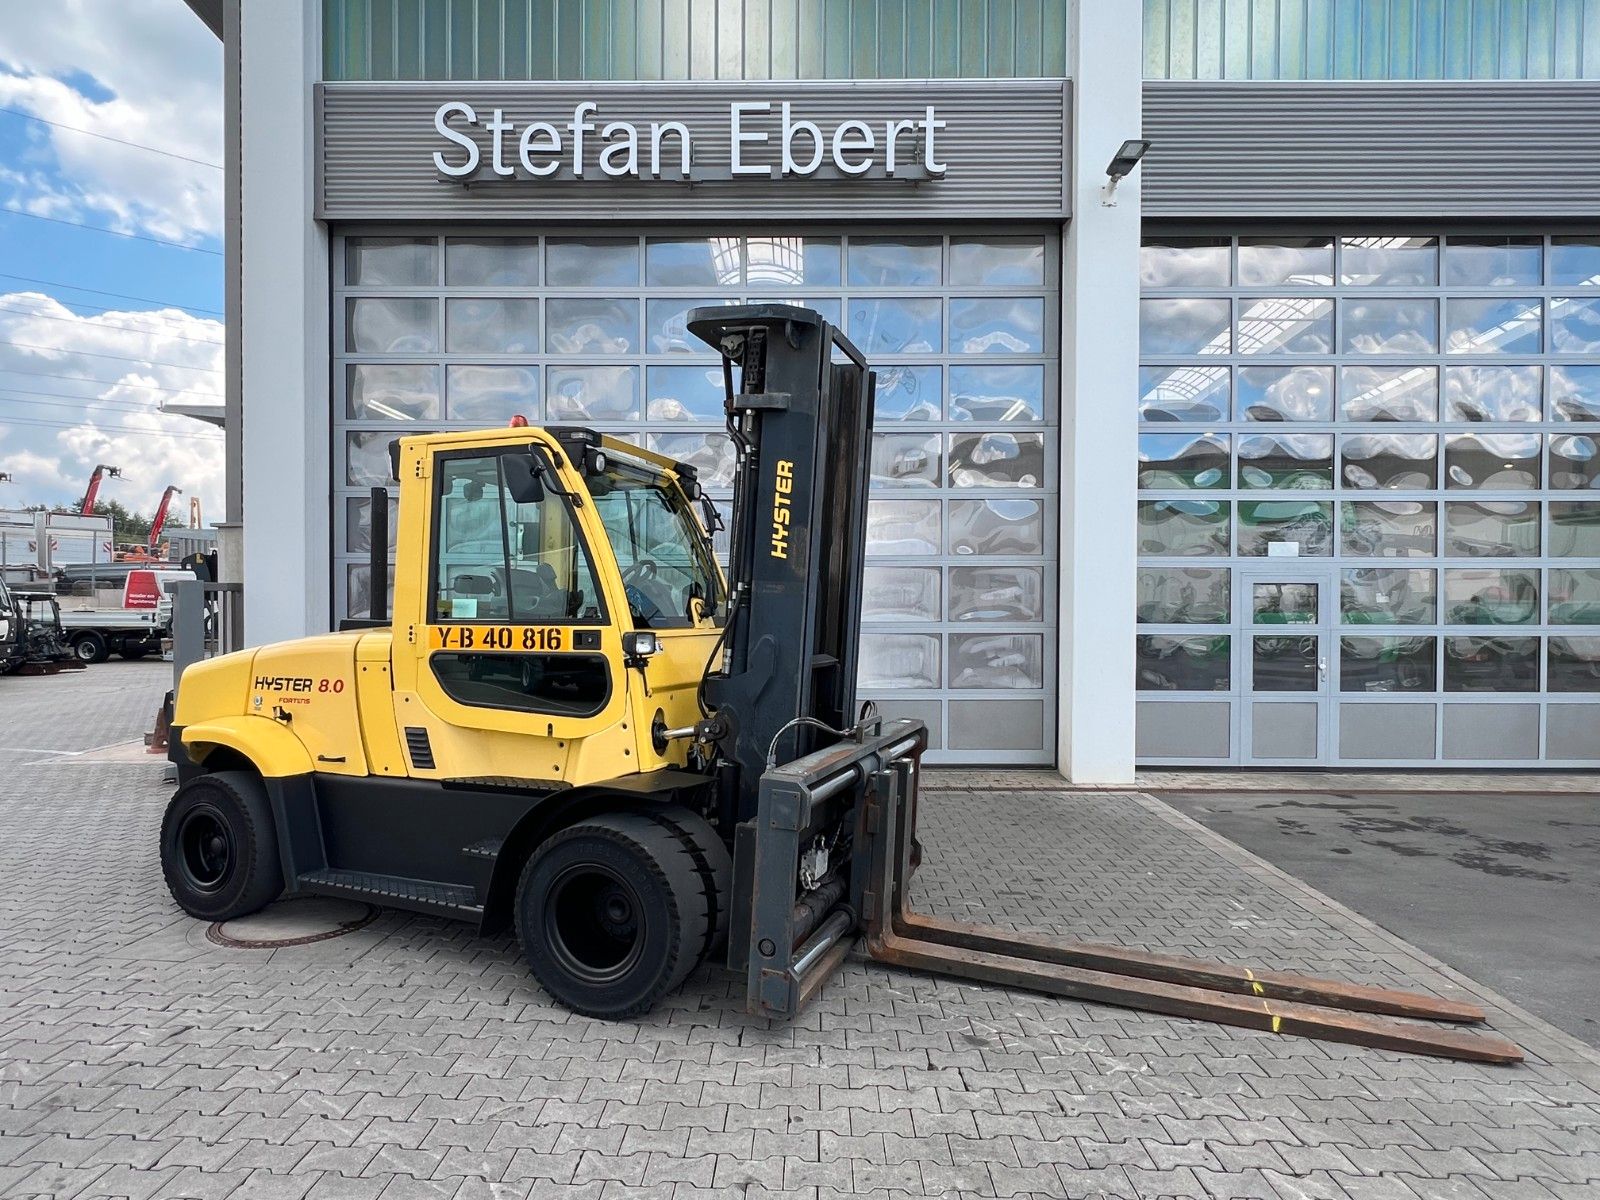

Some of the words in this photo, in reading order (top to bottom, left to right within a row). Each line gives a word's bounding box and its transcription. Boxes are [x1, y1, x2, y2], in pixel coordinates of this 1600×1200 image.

[433, 101, 691, 178] Stefan
[730, 101, 947, 178] Ebert
[770, 460, 794, 559] HYSTER
[482, 627, 513, 649] 40
[522, 628, 562, 650] 816
[254, 676, 312, 692] HYSTER
[318, 678, 344, 693] 8.0
